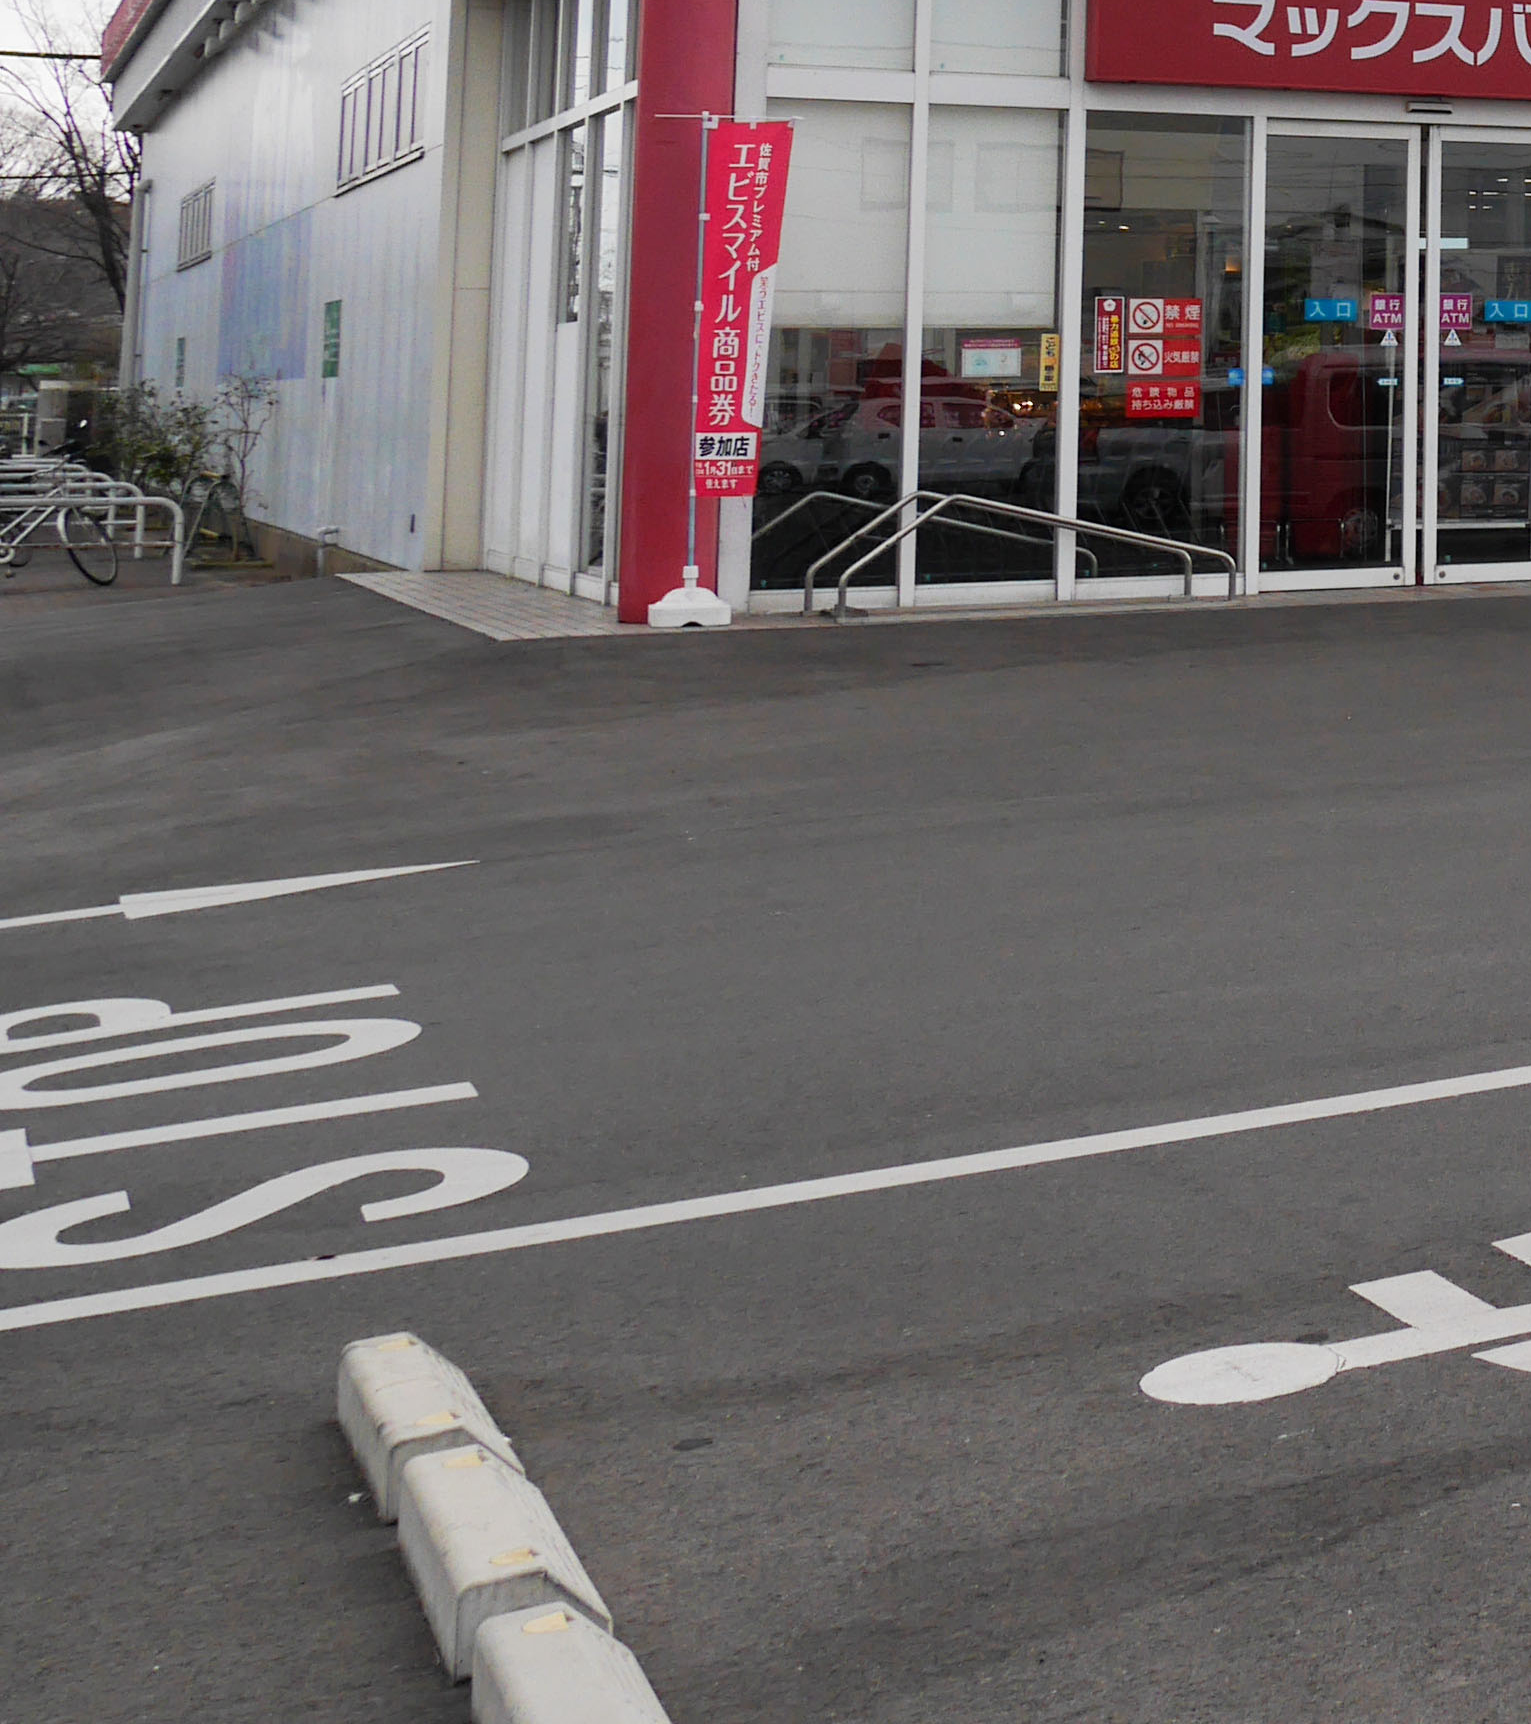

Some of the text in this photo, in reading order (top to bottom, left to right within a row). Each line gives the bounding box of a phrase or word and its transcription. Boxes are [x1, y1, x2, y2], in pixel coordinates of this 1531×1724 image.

[709, 144, 755, 426] エビスマイル商品券
[1310, 301, 1350, 317] 入口
[1375, 299, 1400, 310] 銀行
[1443, 299, 1468, 310] 銀行
[1489, 302, 1528, 318] 入口
[1165, 305, 1200, 320] 禁煙
[1373, 313, 1401, 323] ATM
[1441, 313, 1469, 323] ATM
[699, 436, 750, 457] 参加店
